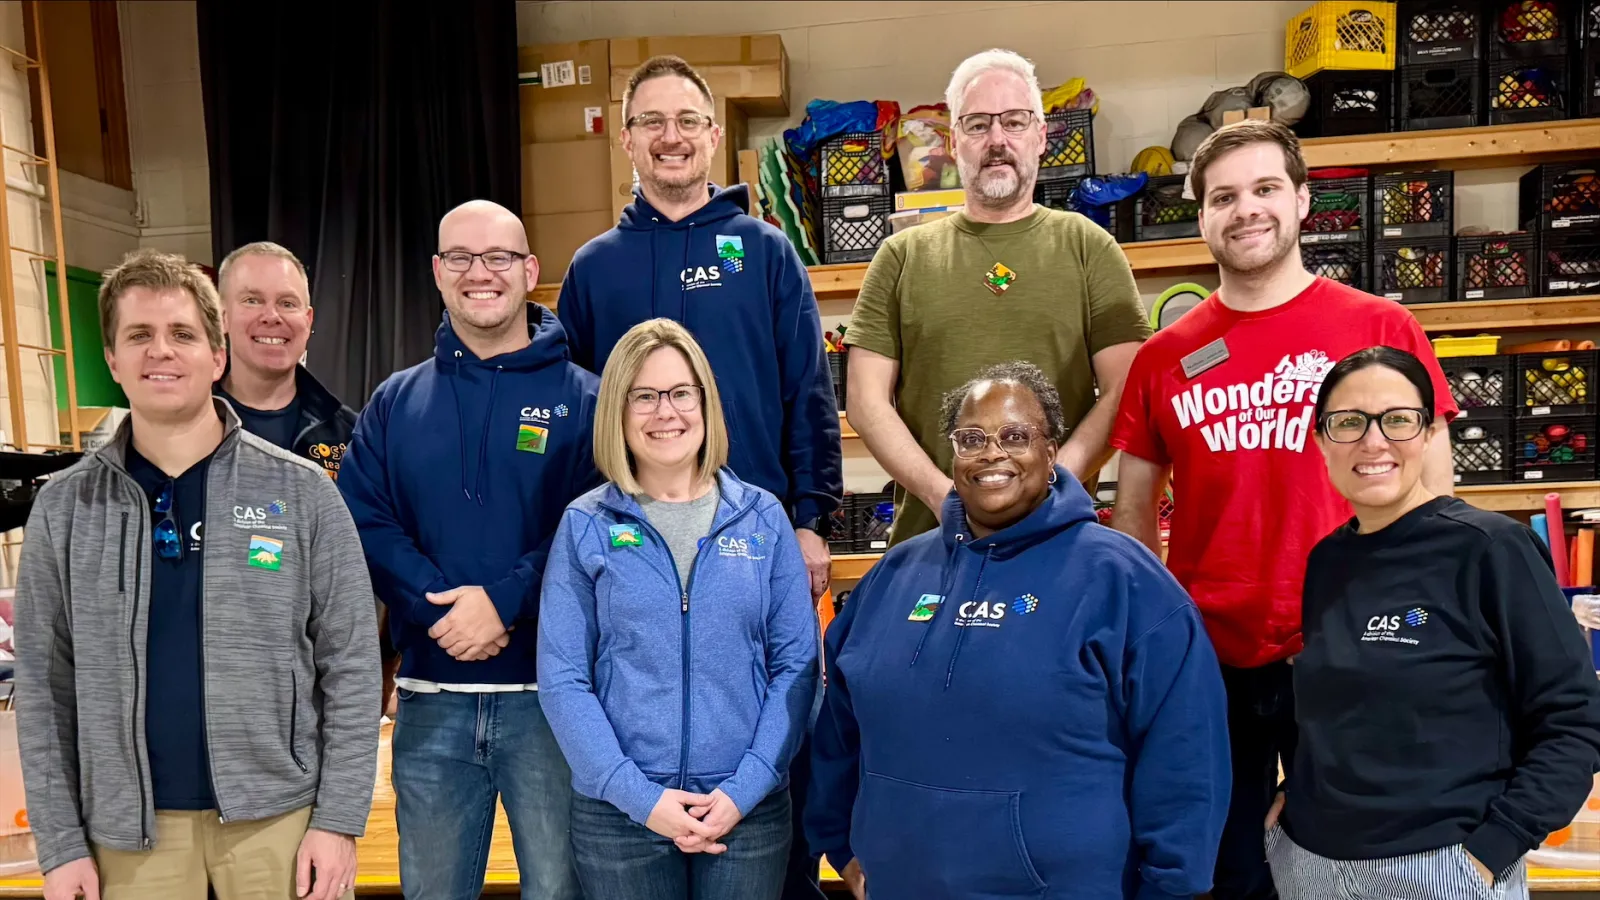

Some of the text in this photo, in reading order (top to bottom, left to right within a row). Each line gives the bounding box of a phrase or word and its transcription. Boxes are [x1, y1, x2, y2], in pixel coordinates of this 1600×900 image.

[680, 266, 720, 283] CAS
[1171, 373, 1322, 429] Wonders
[520, 407, 551, 419] CAS
[1238, 407, 1276, 423] of Our
[1200, 405, 1314, 453] World
[323, 459, 340, 470] tea
[233, 505, 267, 520] CAS
[718, 536, 748, 549] CAS
[959, 601, 1007, 619] CAS
[1367, 615, 1401, 631] CAS
